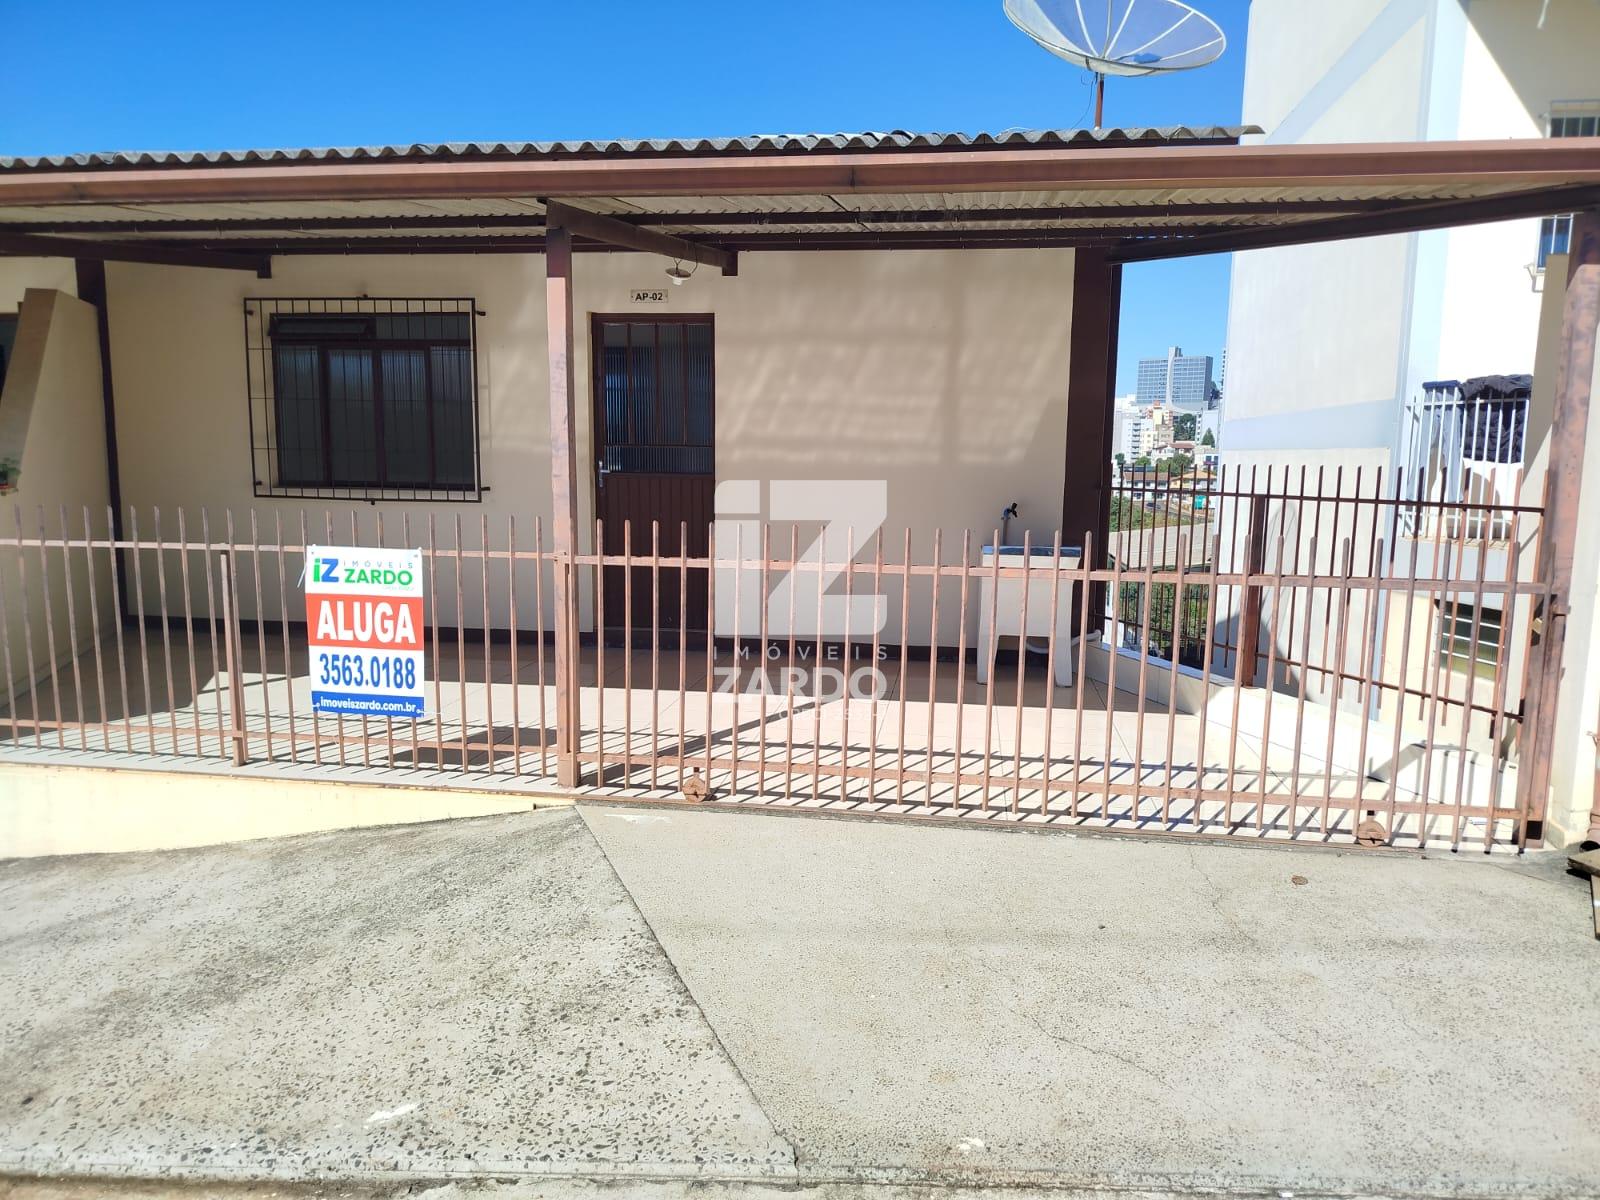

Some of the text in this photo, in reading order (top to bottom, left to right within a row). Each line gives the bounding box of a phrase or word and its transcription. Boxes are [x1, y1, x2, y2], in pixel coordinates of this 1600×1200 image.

[635, 292, 663, 301] AP-02
[344, 560, 414, 569] IMÓVEIS
[344, 568, 413, 586] ZARDO
[316, 600, 417, 644] ALUGA
[319, 653, 416, 690] 3563.0188
[320, 696, 418, 714] imoveiszardo.com.br
